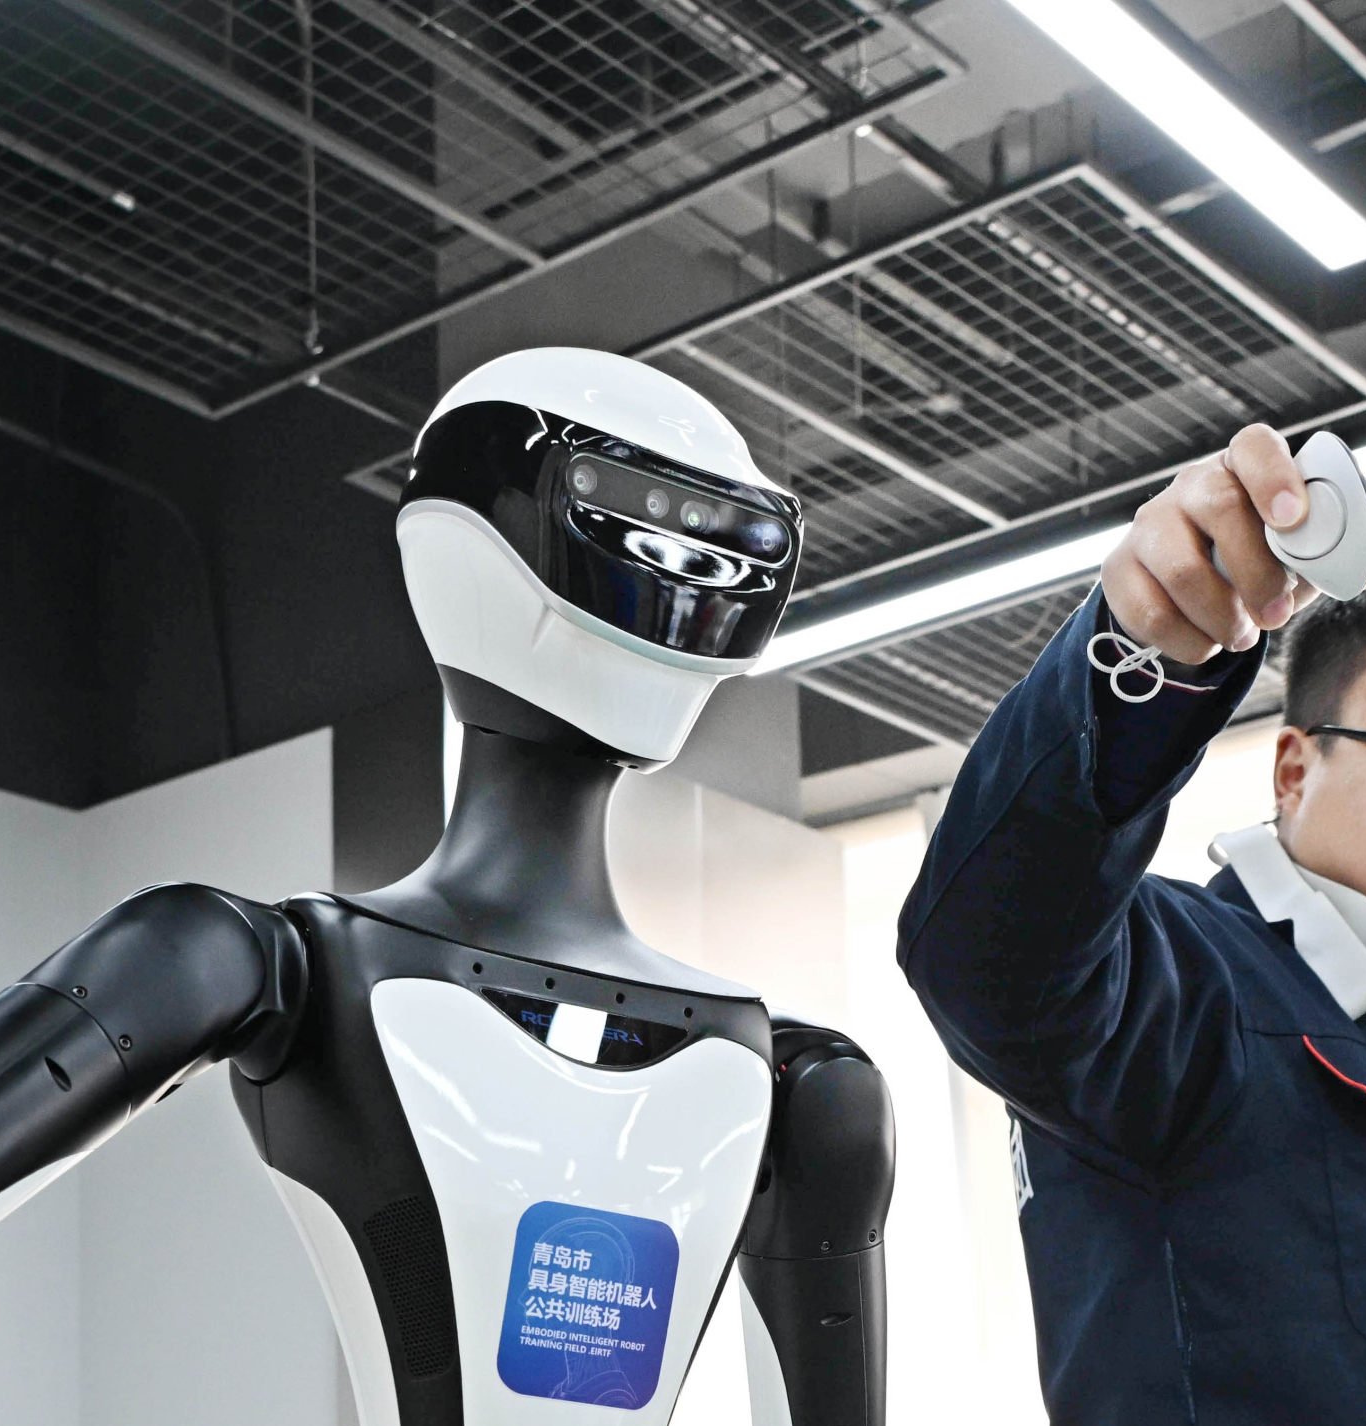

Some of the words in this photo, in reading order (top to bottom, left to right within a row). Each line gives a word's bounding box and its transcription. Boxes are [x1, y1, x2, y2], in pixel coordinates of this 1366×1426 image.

[521, 1010, 643, 1046] ROERA
[533, 1242, 592, 1272] 青岛市
[528, 1269, 657, 1310] 具身智能机器人
[525, 1296, 621, 1331] 公共训练场
[520, 1336, 562, 1350] TRAINING
[564, 1343, 586, 1354] FIELD
[521, 1325, 567, 1340] EMBODIED
[569, 1332, 619, 1348] INTELLIGENT
[620, 1340, 645, 1352] ROBOT
